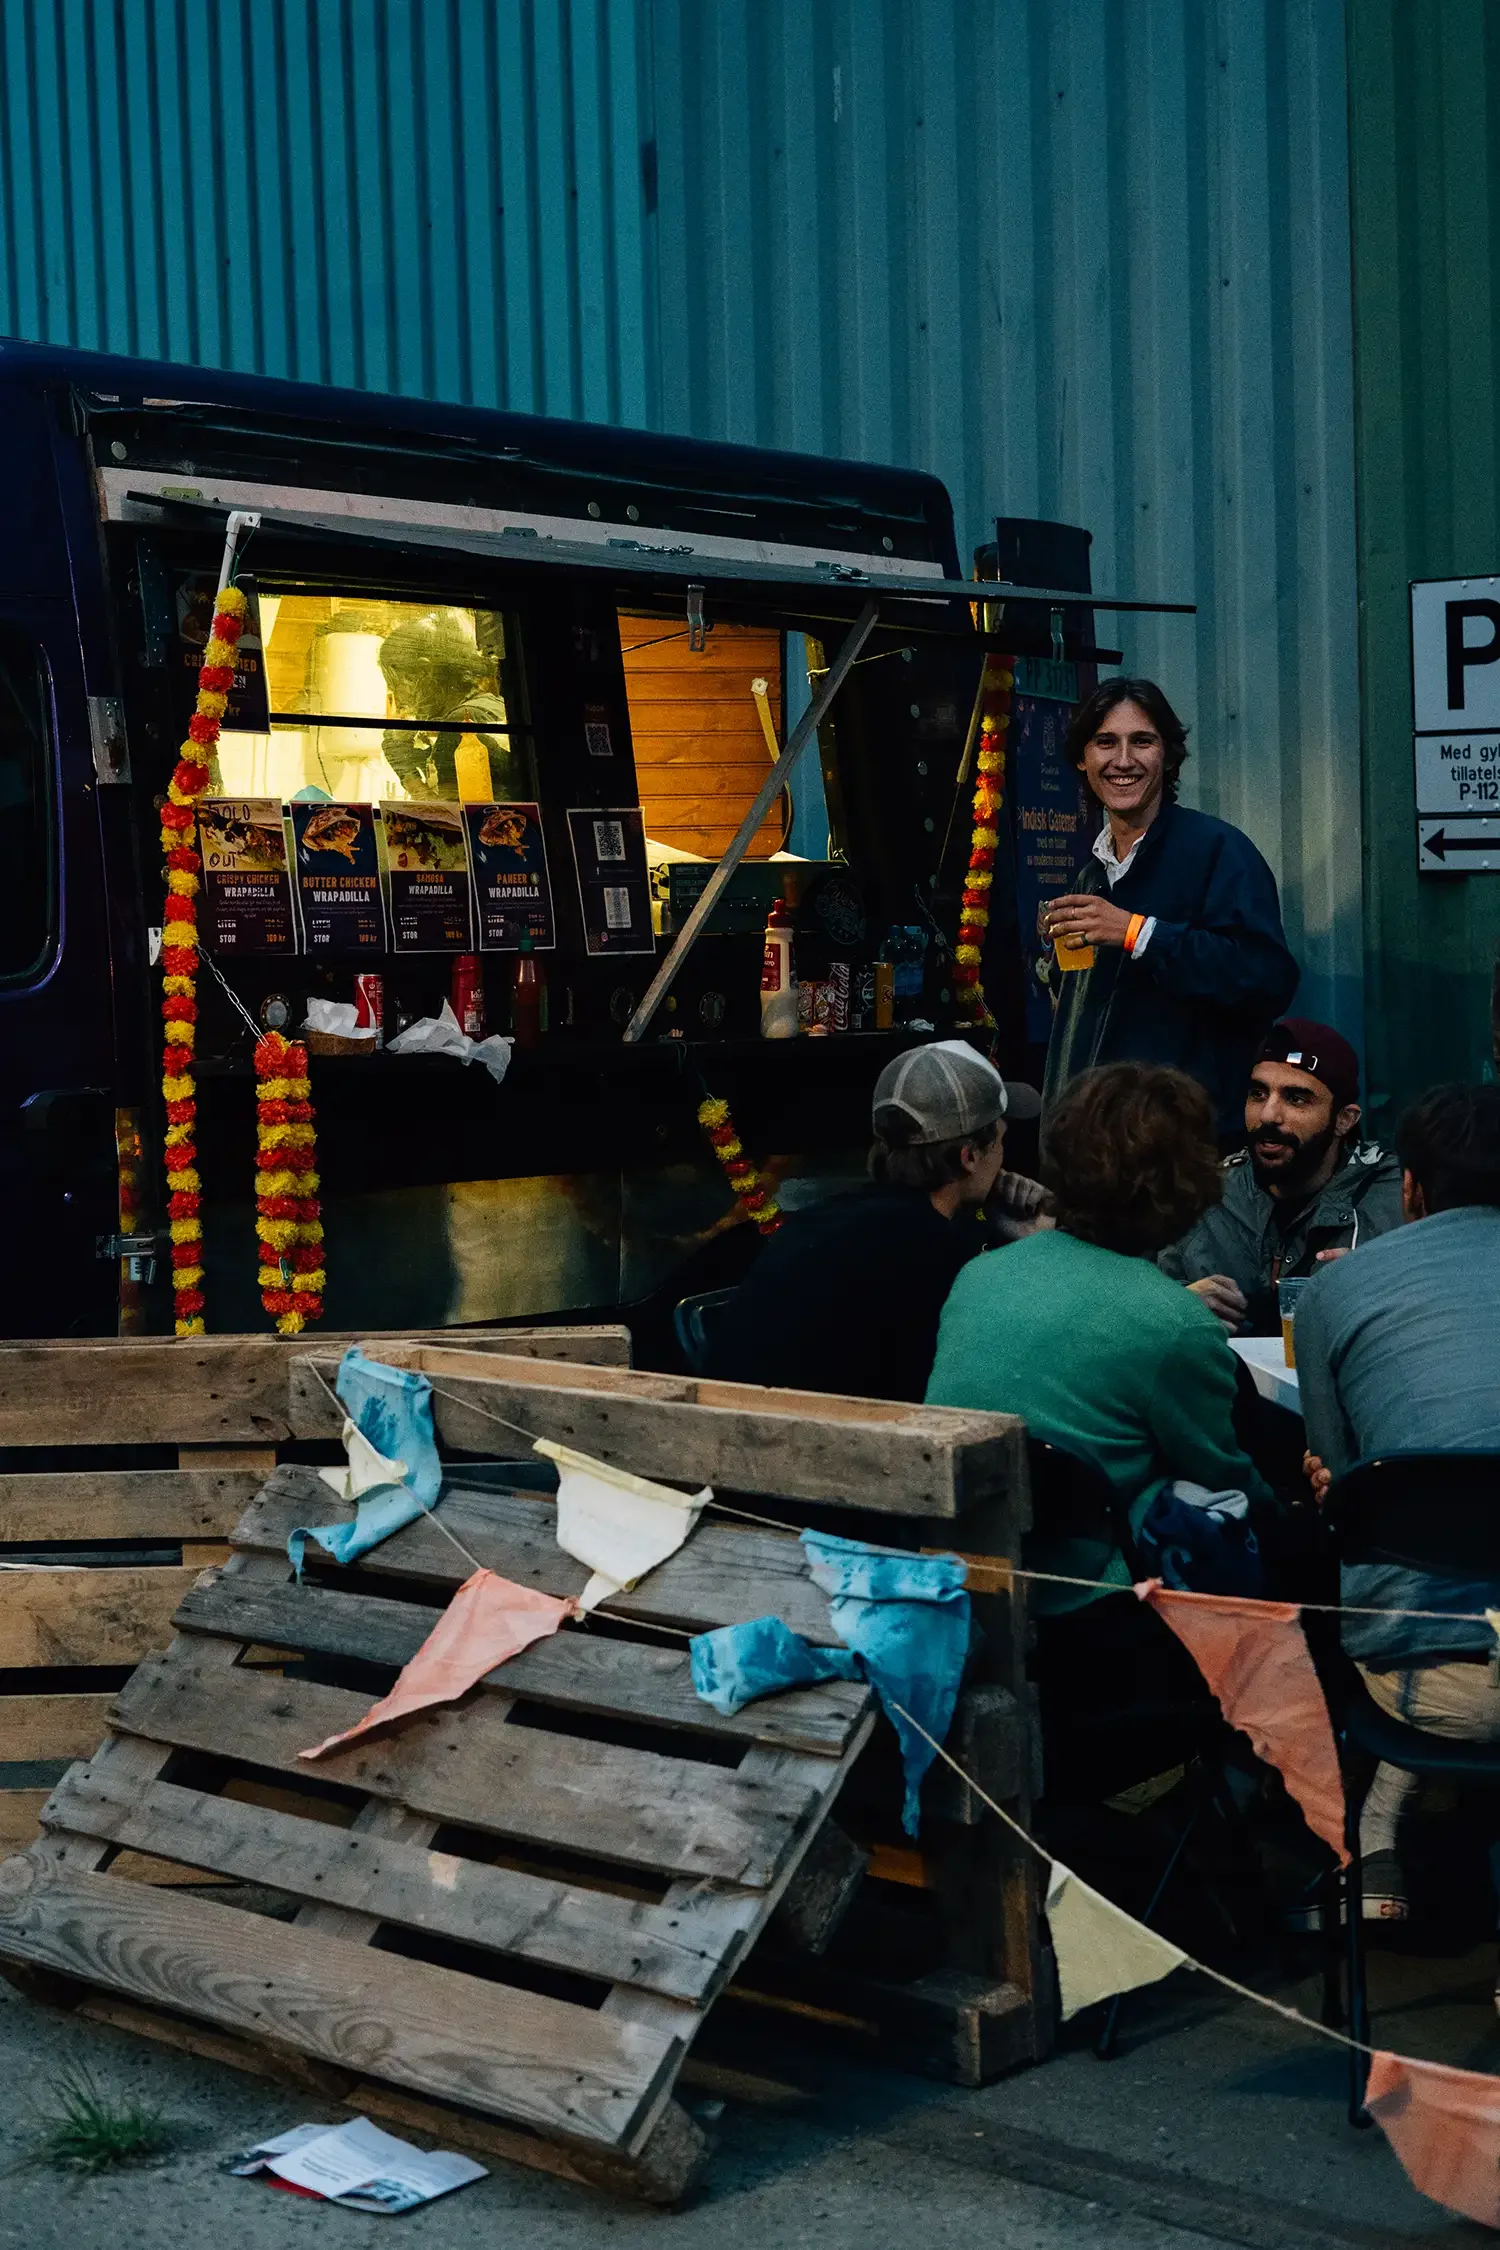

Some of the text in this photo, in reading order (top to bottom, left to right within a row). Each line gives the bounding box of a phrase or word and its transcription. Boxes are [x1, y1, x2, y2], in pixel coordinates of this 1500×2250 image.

[1445, 598, 1500, 710] P
[1441, 744, 1471, 760] Med
[1460, 782, 1499, 800] P-112
[1022, 806, 1048, 831] Indisk
[209, 852, 237, 868] OUT
[216, 874, 280, 885] CRISPY CHICKEN
[303, 876, 376, 889] BUTTER CHICKEN
[415, 873, 444, 884] SAMOSA
[224, 886, 275, 898] WRAPADILLA
[313, 890, 370, 902] WRAPADILLA
[408, 885, 453, 895] WRAPADILLA
[488, 886, 540, 898] WRAPADILLA
[219, 934, 236, 943] STOR
[313, 934, 330, 943] STOR
[402, 931, 418, 940] STOR
[488, 928, 503, 938] STOR
